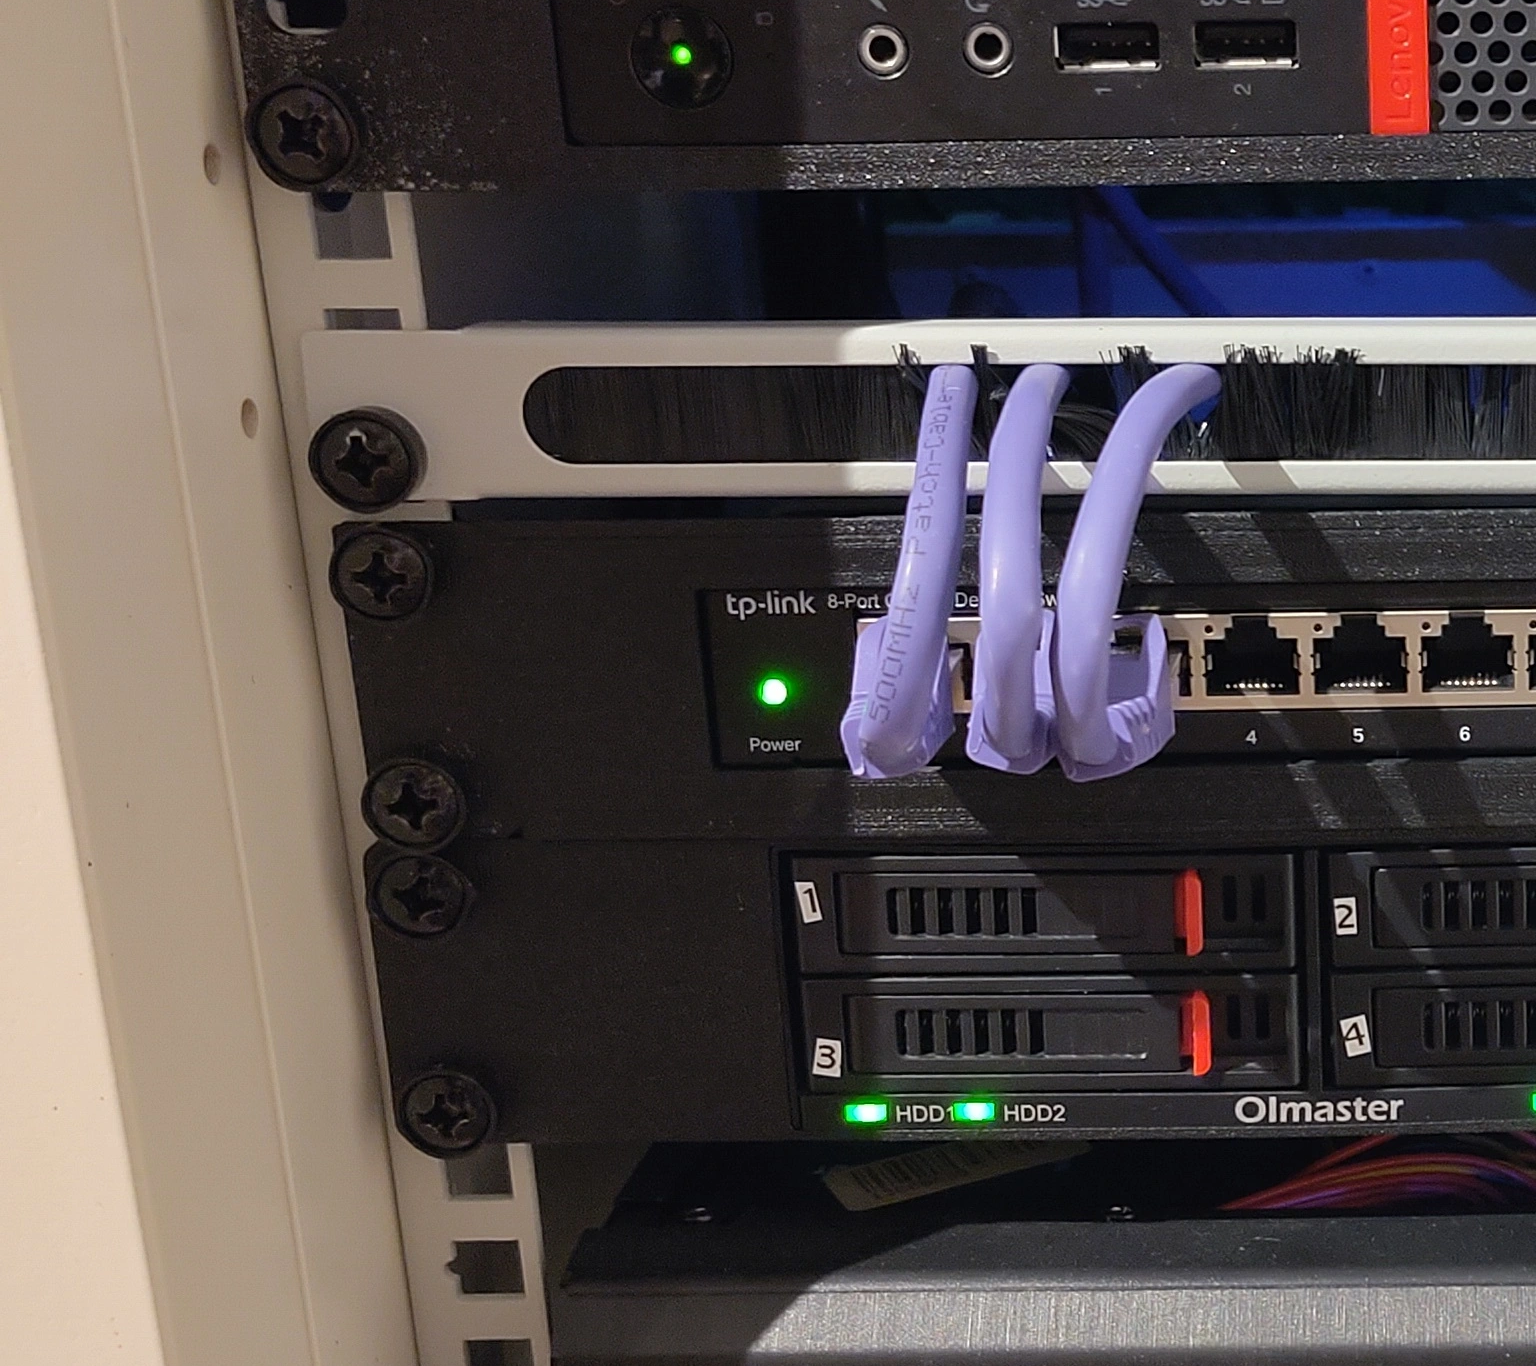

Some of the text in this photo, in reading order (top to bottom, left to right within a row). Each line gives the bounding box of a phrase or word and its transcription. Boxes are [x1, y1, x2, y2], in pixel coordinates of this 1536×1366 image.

[1233, 83, 1252, 96] 2
[726, 590, 816, 621] tp-link
[827, 592, 880, 610] 8-Port
[868, 584, 921, 726] 500MHz
[1245, 730, 1258, 745] 4
[1352, 727, 1365, 743] 5
[1459, 726, 1471, 742] 6
[749, 737, 802, 753] Power
[803, 888, 818, 914] 1
[1335, 904, 1355, 929] 2
[1344, 1022, 1365, 1047] 4
[816, 1045, 837, 1070] 3
[1003, 1104, 1066, 1123] HDD2
